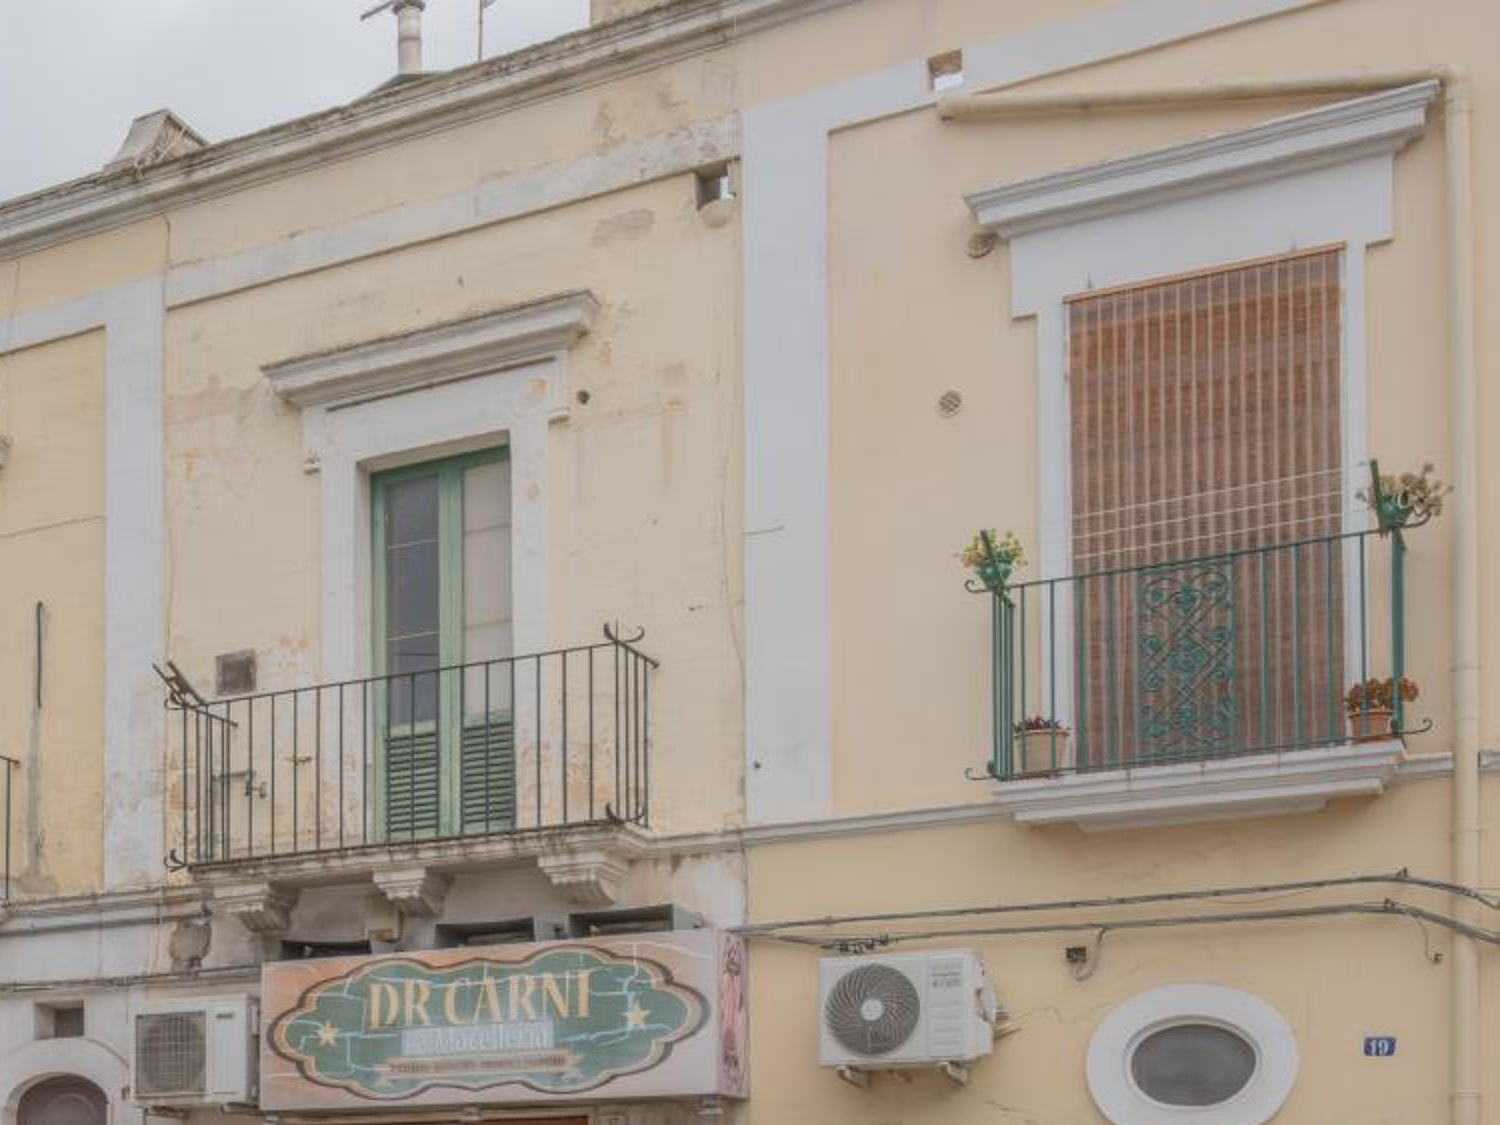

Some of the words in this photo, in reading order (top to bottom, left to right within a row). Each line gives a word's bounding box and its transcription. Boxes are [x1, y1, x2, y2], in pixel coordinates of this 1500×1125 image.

[369, 977, 432, 1029] DR
[444, 969, 591, 1025] CARNI
[1370, 1039, 1389, 1056] 19
